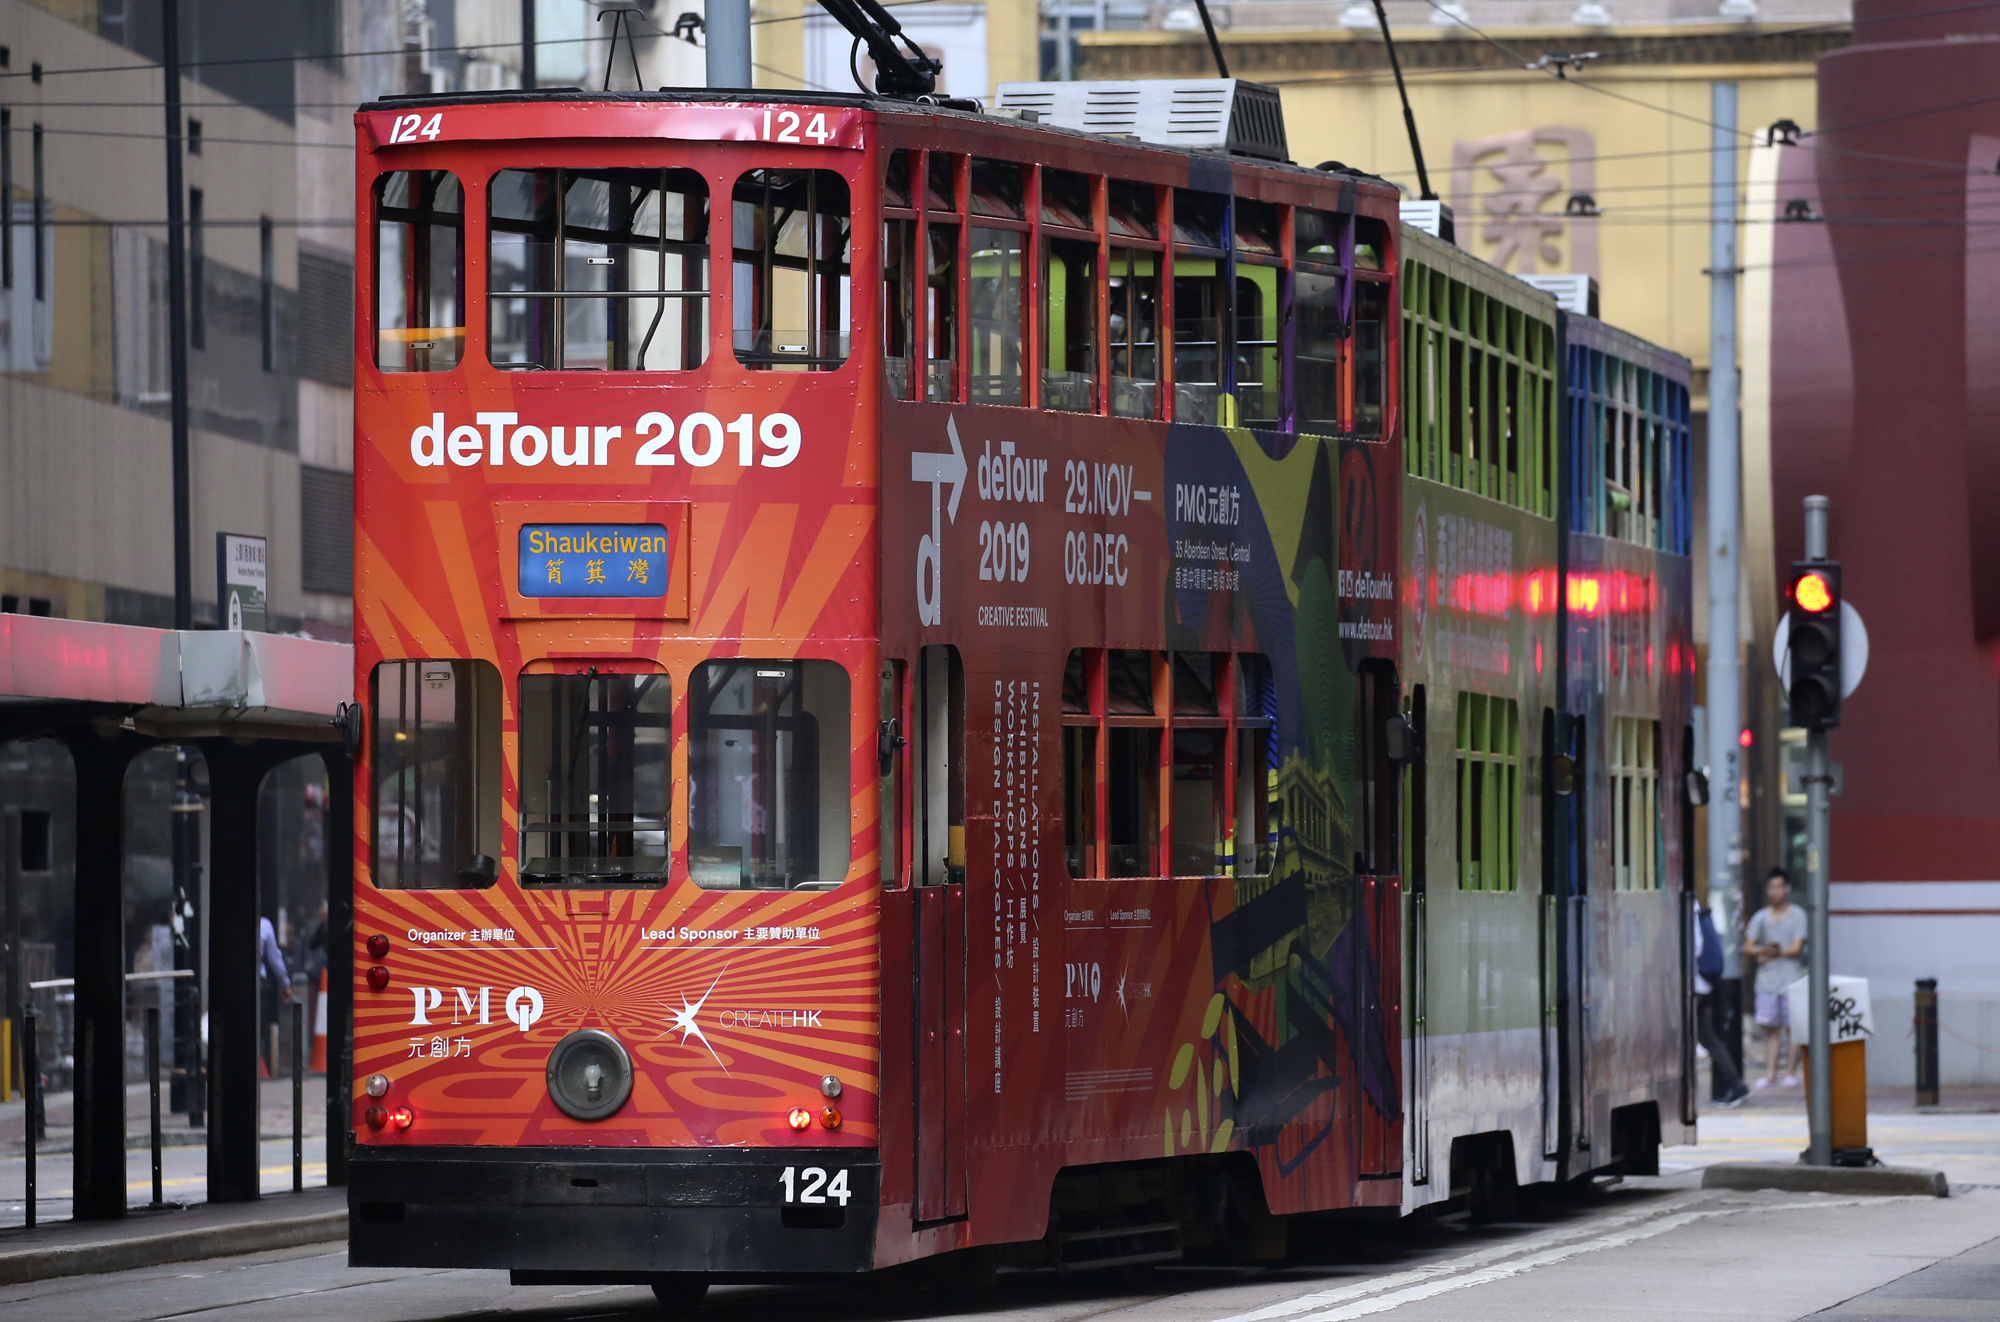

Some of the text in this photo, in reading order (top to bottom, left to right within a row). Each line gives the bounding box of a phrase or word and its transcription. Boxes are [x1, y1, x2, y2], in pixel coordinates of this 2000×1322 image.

[389, 113, 444, 144] 124
[762, 110, 829, 145] 124
[410, 411, 802, 468] deTour 2019
[978, 440, 1048, 503] deTour
[529, 530, 666, 554] Shaukeiwan
[979, 520, 1030, 583] 2019
[1064, 530, 1129, 587] 08.DEC
[1175, 540, 1251, 563] 35 Aberdeen Street, Central
[545, 558, 650, 585] 筲箕灣
[1355, 571, 1393, 600] deTourhk
[978, 606, 1049, 627] CREATIVE FESTIVAL
[1338, 616, 1393, 640] www.detour.hk
[994, 681, 1002, 788] DESIGN
[1031, 682, 1039, 909] INSTALLATIONS
[408, 928, 515, 944] Organizer 主辦單位
[641, 926, 820, 942] Lead Sponsor 主要贊助單位
[1006, 899, 1014, 969] 工作坊
[1020, 897, 1027, 944] 展覽
[541, 924, 637, 960] NEW
[565, 961, 616, 980] NEW
[1065, 962, 1101, 1003] PMQ
[408, 986, 544, 1032] PMQ
[719, 1010, 822, 1028] CREATEHK
[408, 1035, 472, 1058] 元創方
[779, 1166, 852, 1206] 124
